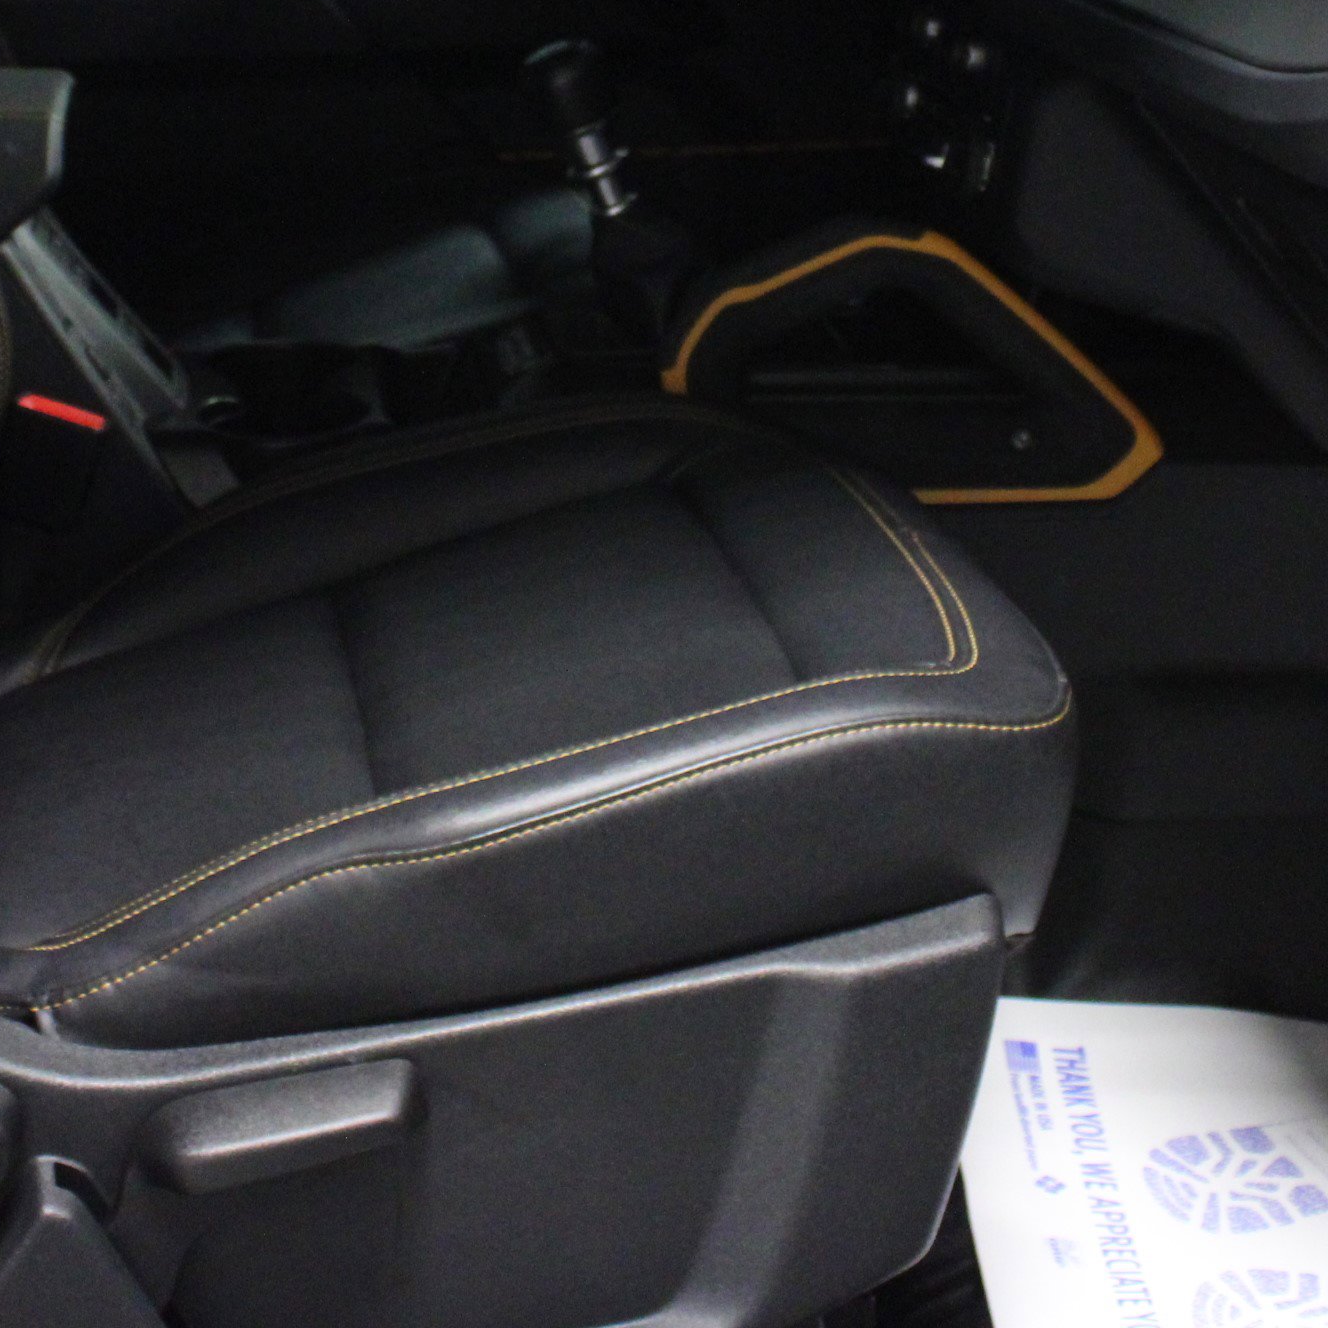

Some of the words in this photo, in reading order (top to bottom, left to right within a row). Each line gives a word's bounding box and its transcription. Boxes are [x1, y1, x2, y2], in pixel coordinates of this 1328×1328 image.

[1052, 1045, 1098, 1109] THANK
[1067, 1112, 1109, 1155] YOU,
[1080, 1162, 1120, 1192] WE
[1087, 1195, 1154, 1308] APPRECIATE
